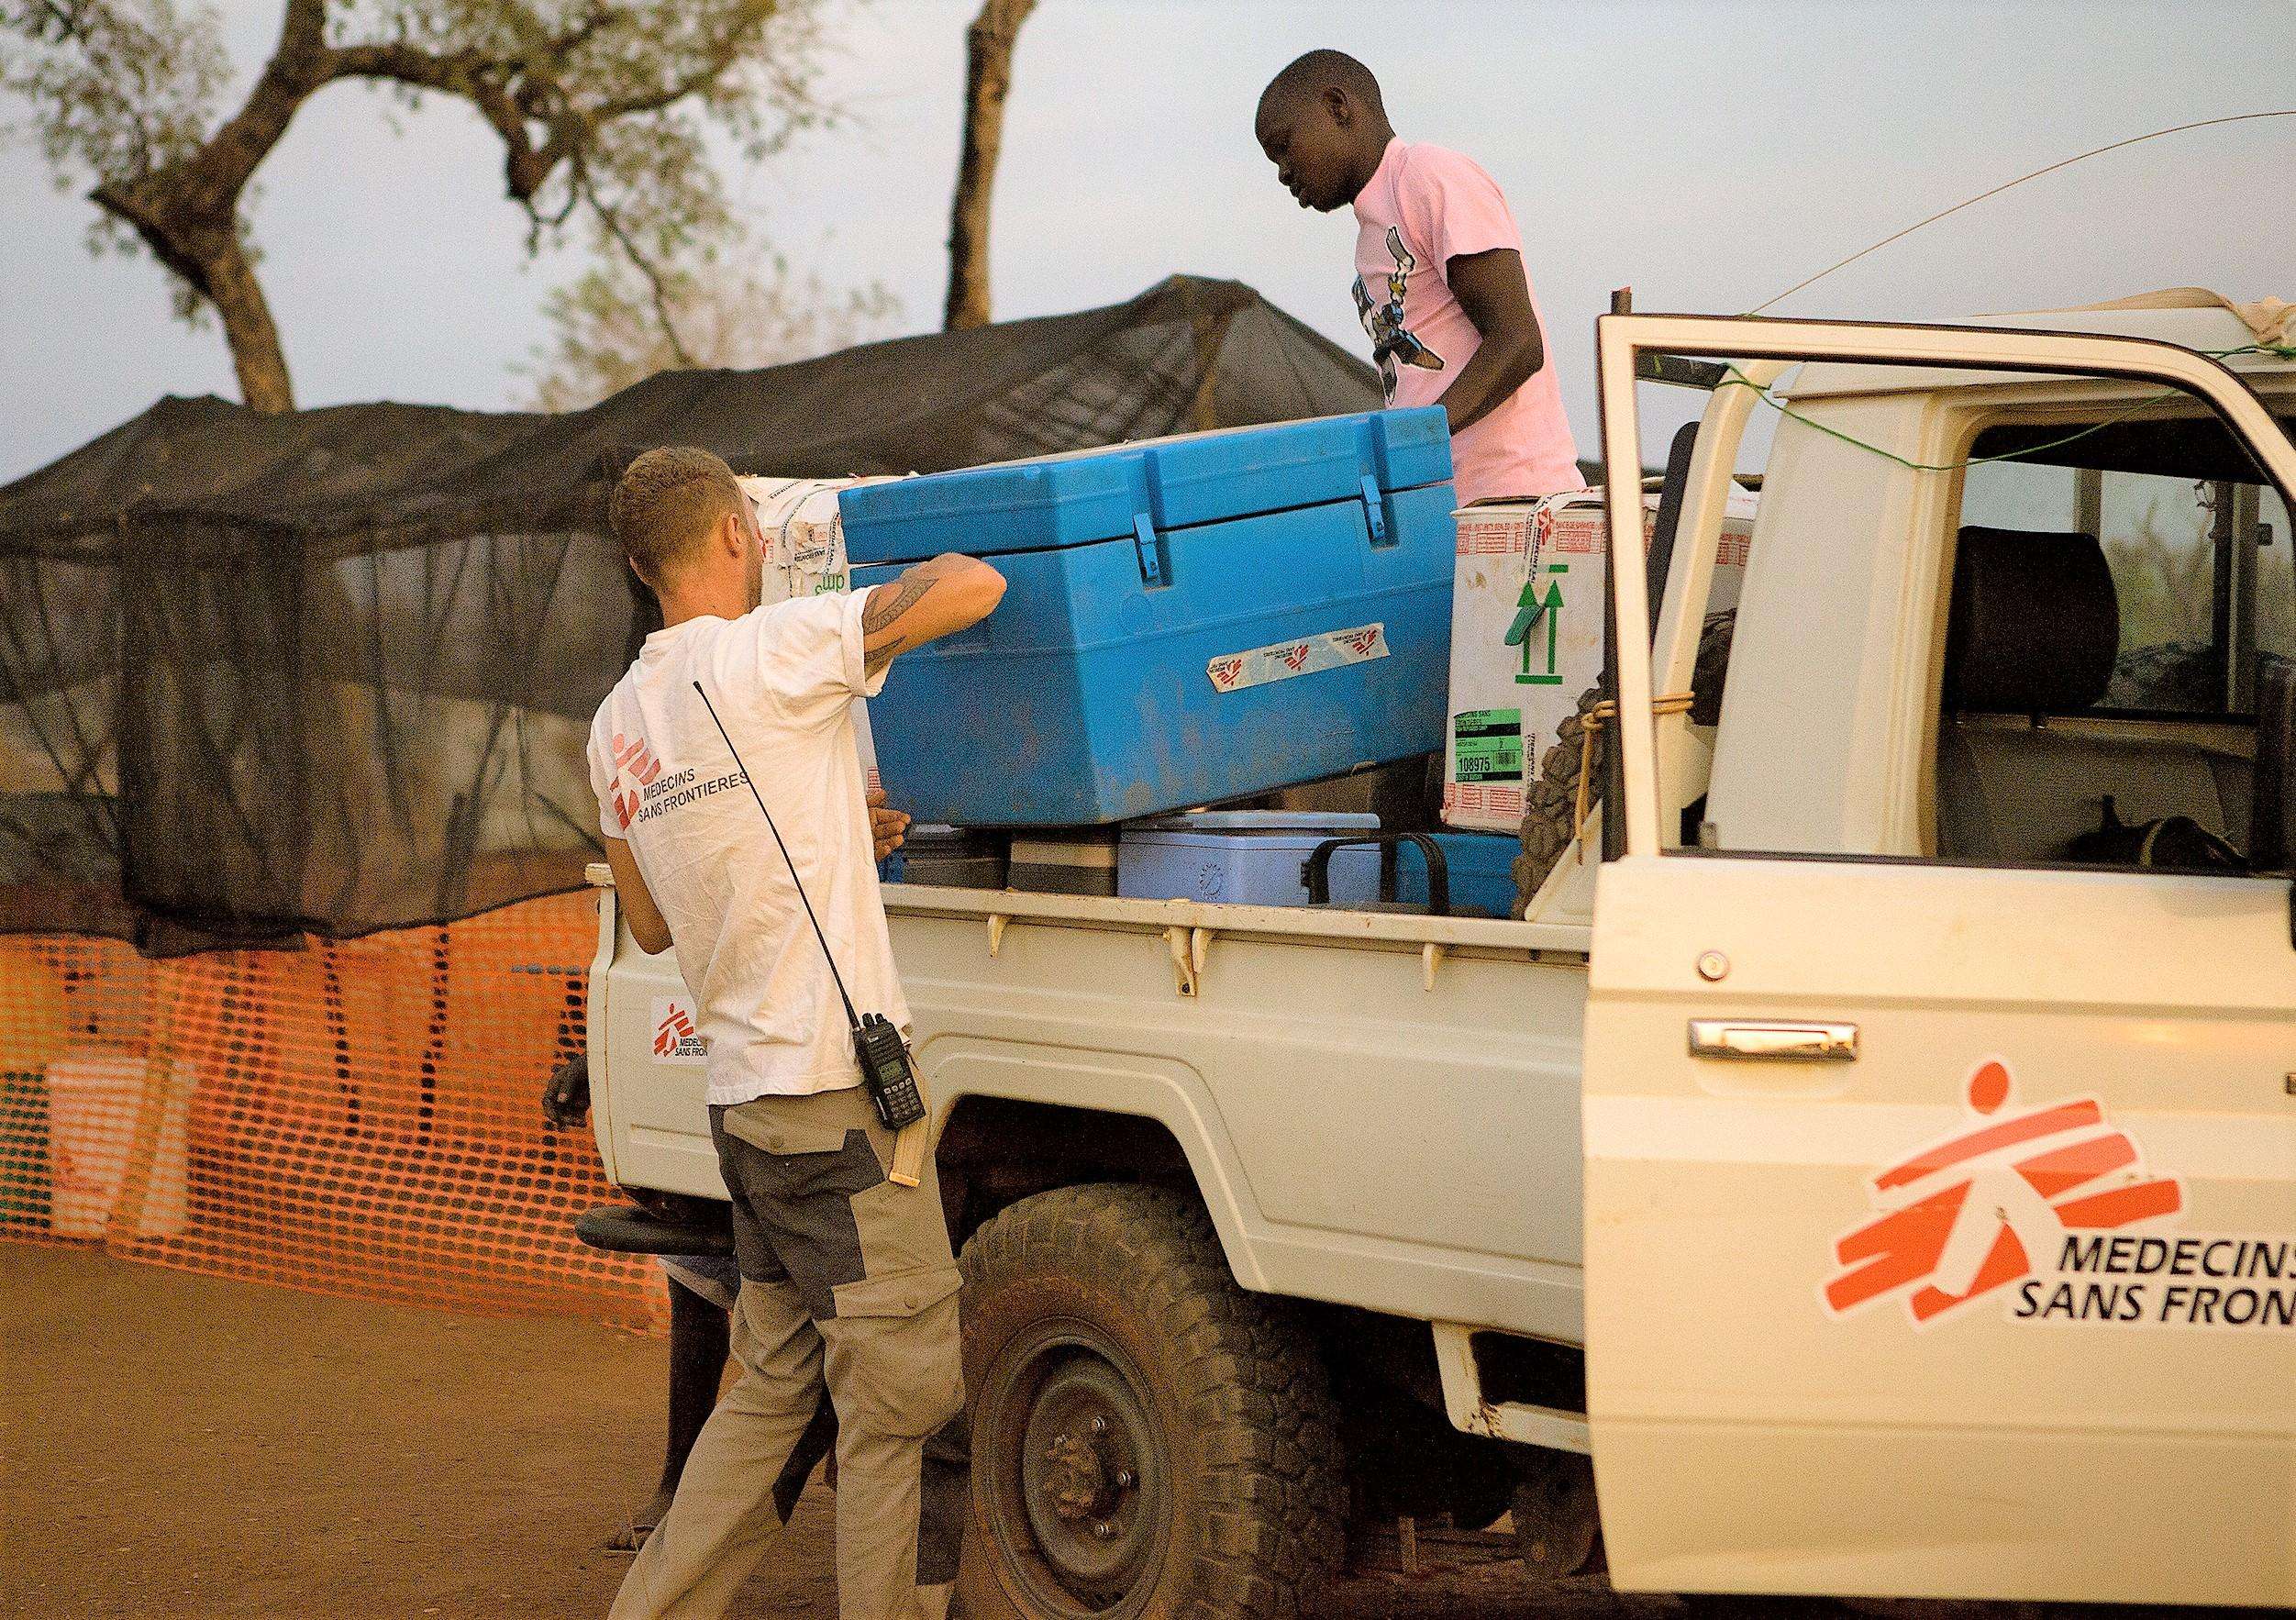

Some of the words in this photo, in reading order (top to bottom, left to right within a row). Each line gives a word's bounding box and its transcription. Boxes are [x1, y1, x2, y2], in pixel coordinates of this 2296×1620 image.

[1459, 756, 1492, 772] 108975
[638, 801, 663, 823] SANS
[663, 771, 750, 813] FRONTIERES
[643, 768, 695, 802] MEDECINS
[675, 1047, 691, 1057] SANS
[2013, 1280, 2145, 1322] SANS
